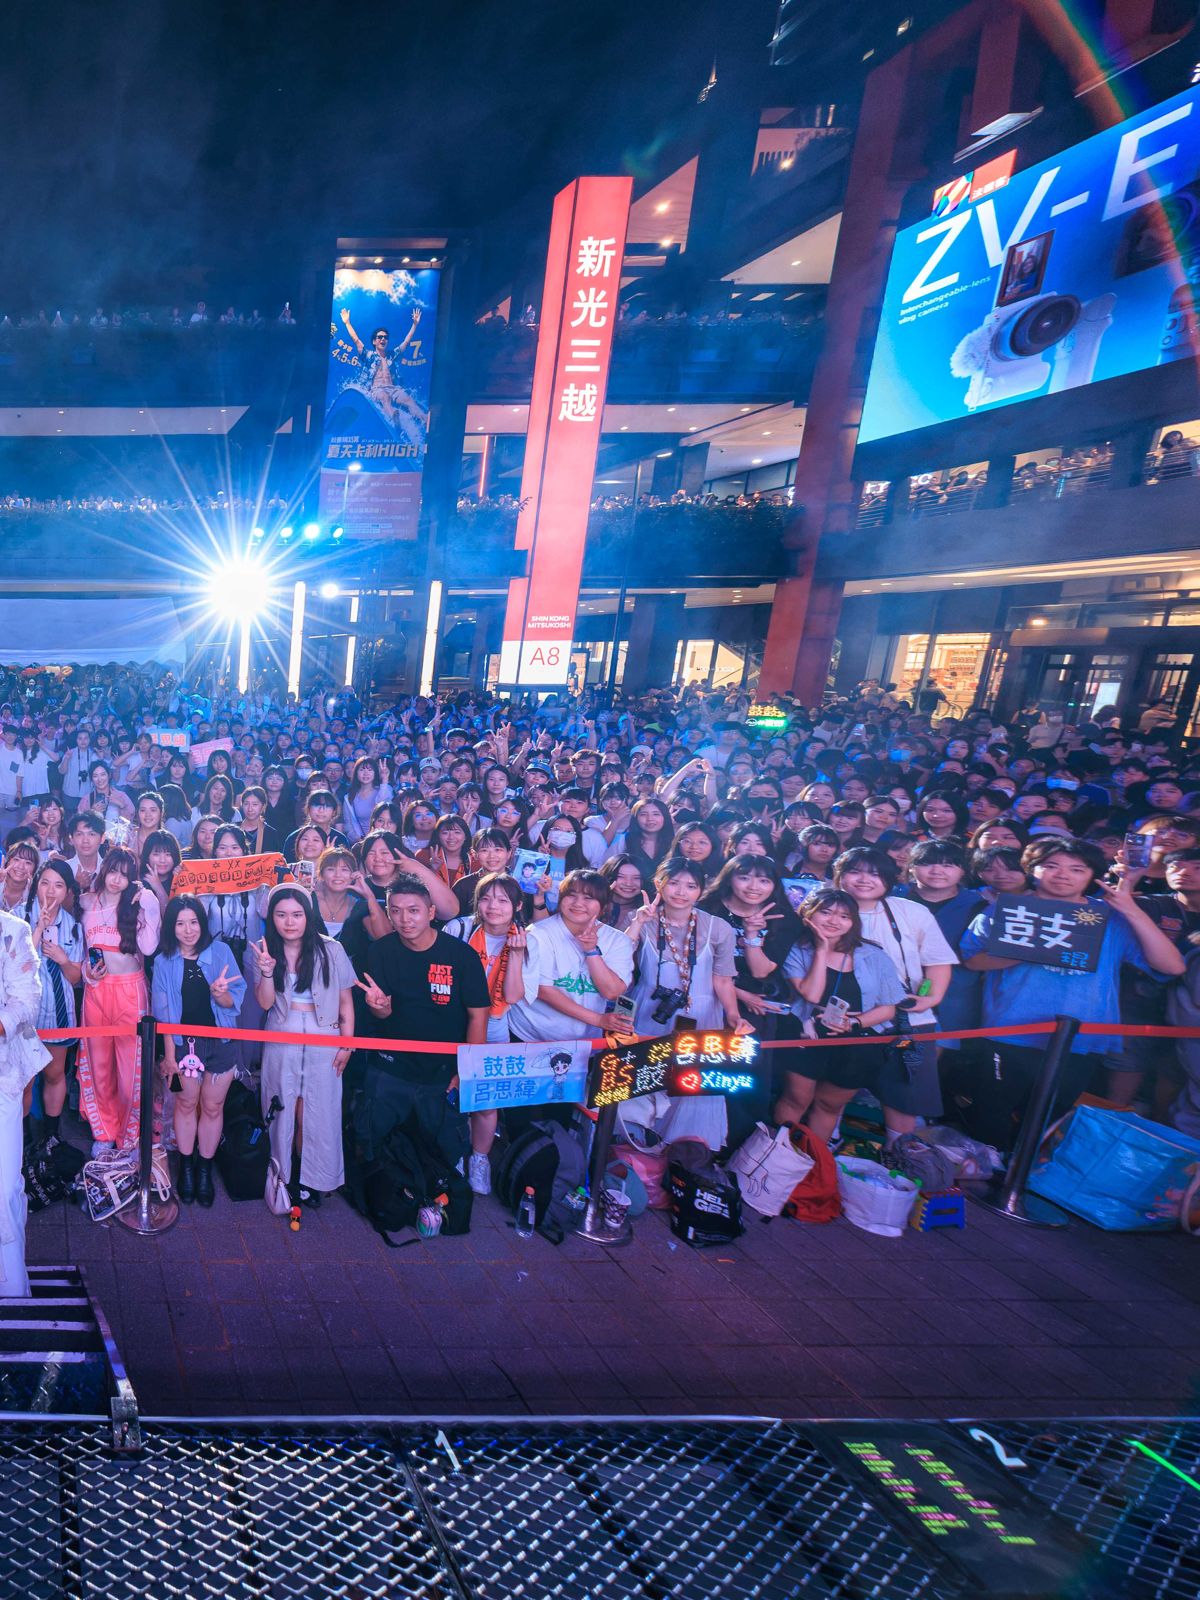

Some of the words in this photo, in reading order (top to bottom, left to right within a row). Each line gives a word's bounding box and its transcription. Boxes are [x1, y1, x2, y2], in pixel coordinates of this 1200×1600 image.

[917, 301, 949, 318] camera
[559, 236, 616, 422] 新光三越
[529, 646, 561, 666] A8
[428, 972, 453, 986] HAVE
[429, 963, 453, 976] JUST
[430, 983, 451, 995] FUN
[483, 1056, 527, 1078] 鼓鼓
[473, 1080, 537, 1104] 呂思緯
[699, 1070, 754, 1093] Xinyu
[434, 1430, 462, 1472] 1
[969, 1427, 1028, 1468] 2
